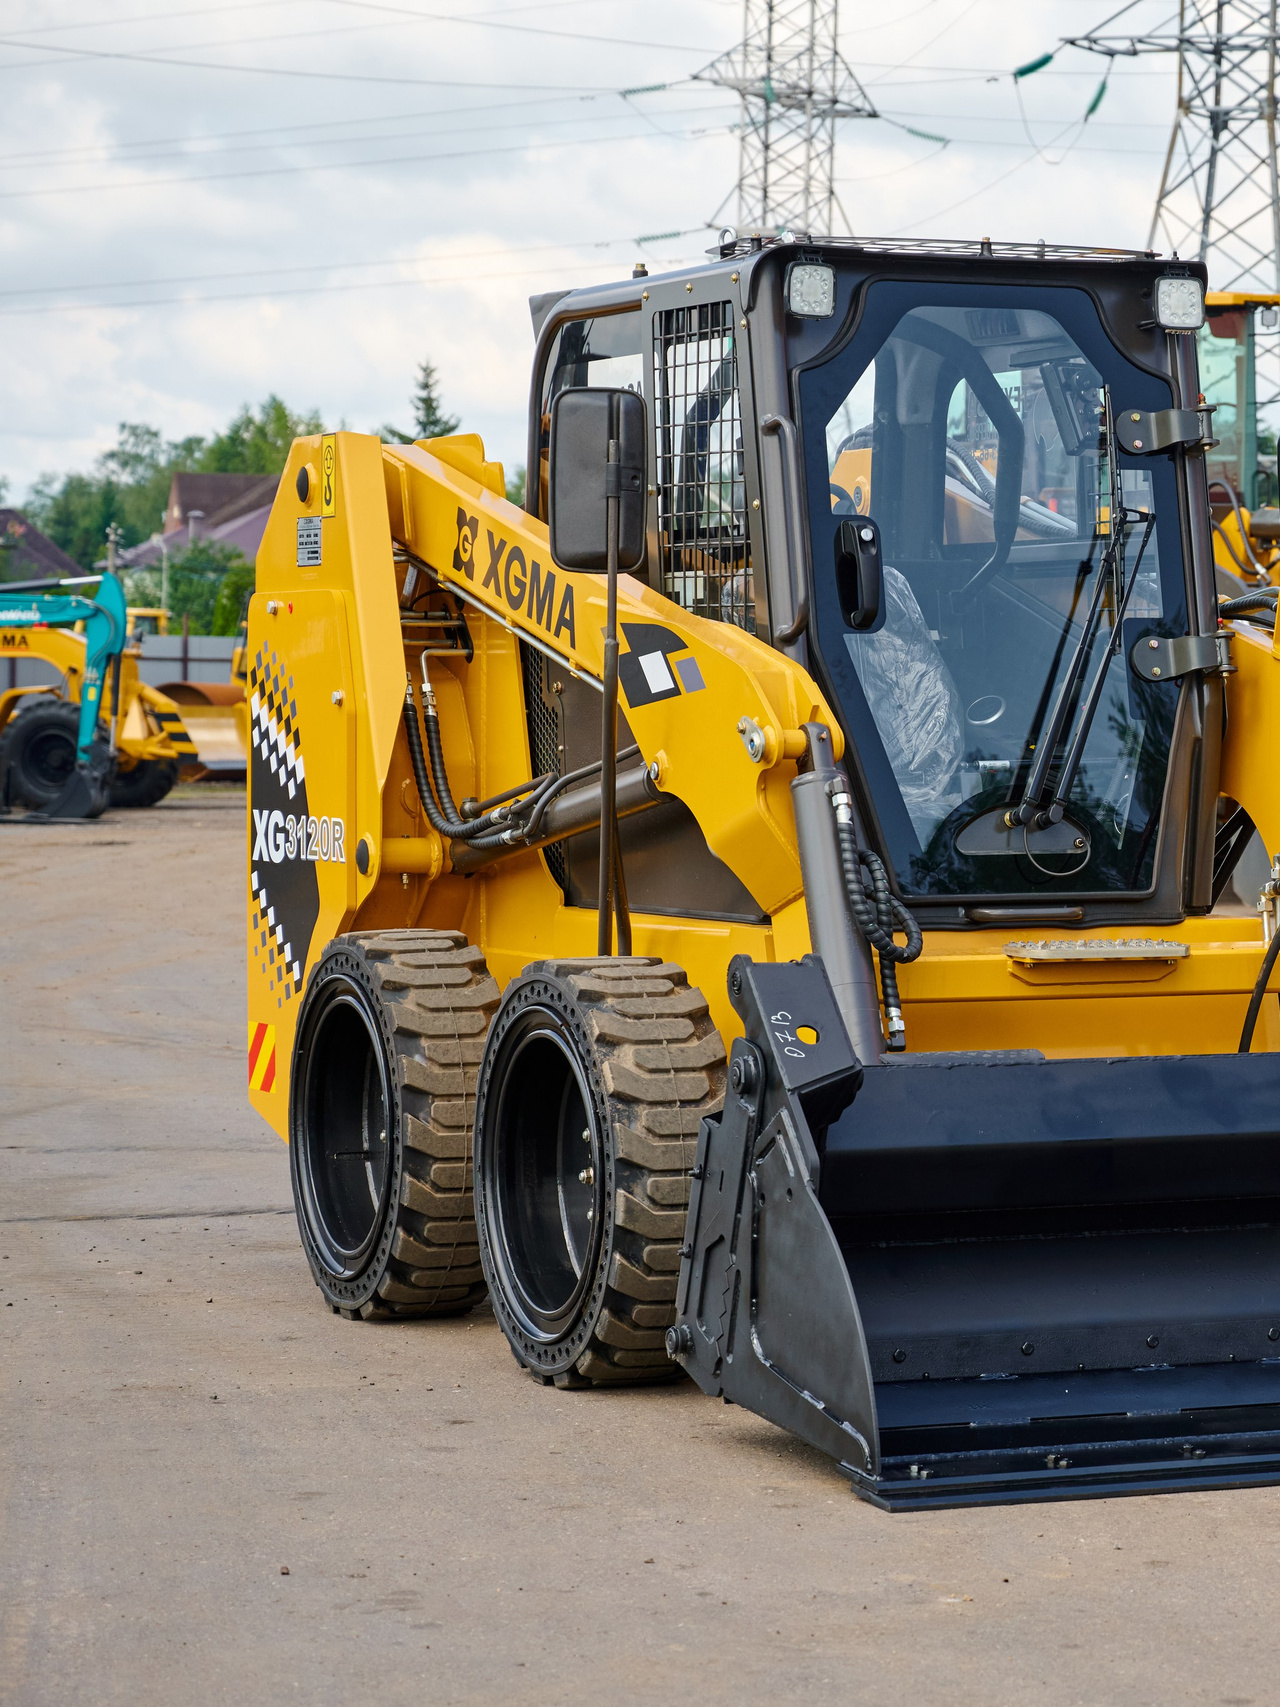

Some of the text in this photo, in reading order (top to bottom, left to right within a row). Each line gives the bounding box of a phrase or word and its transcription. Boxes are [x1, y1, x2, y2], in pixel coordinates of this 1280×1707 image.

[481, 528, 576, 651] XGMA
[1, 635, 29, 647] MA
[252, 809, 346, 864] XG3120R
[770, 1011, 805, 1058] 0713
